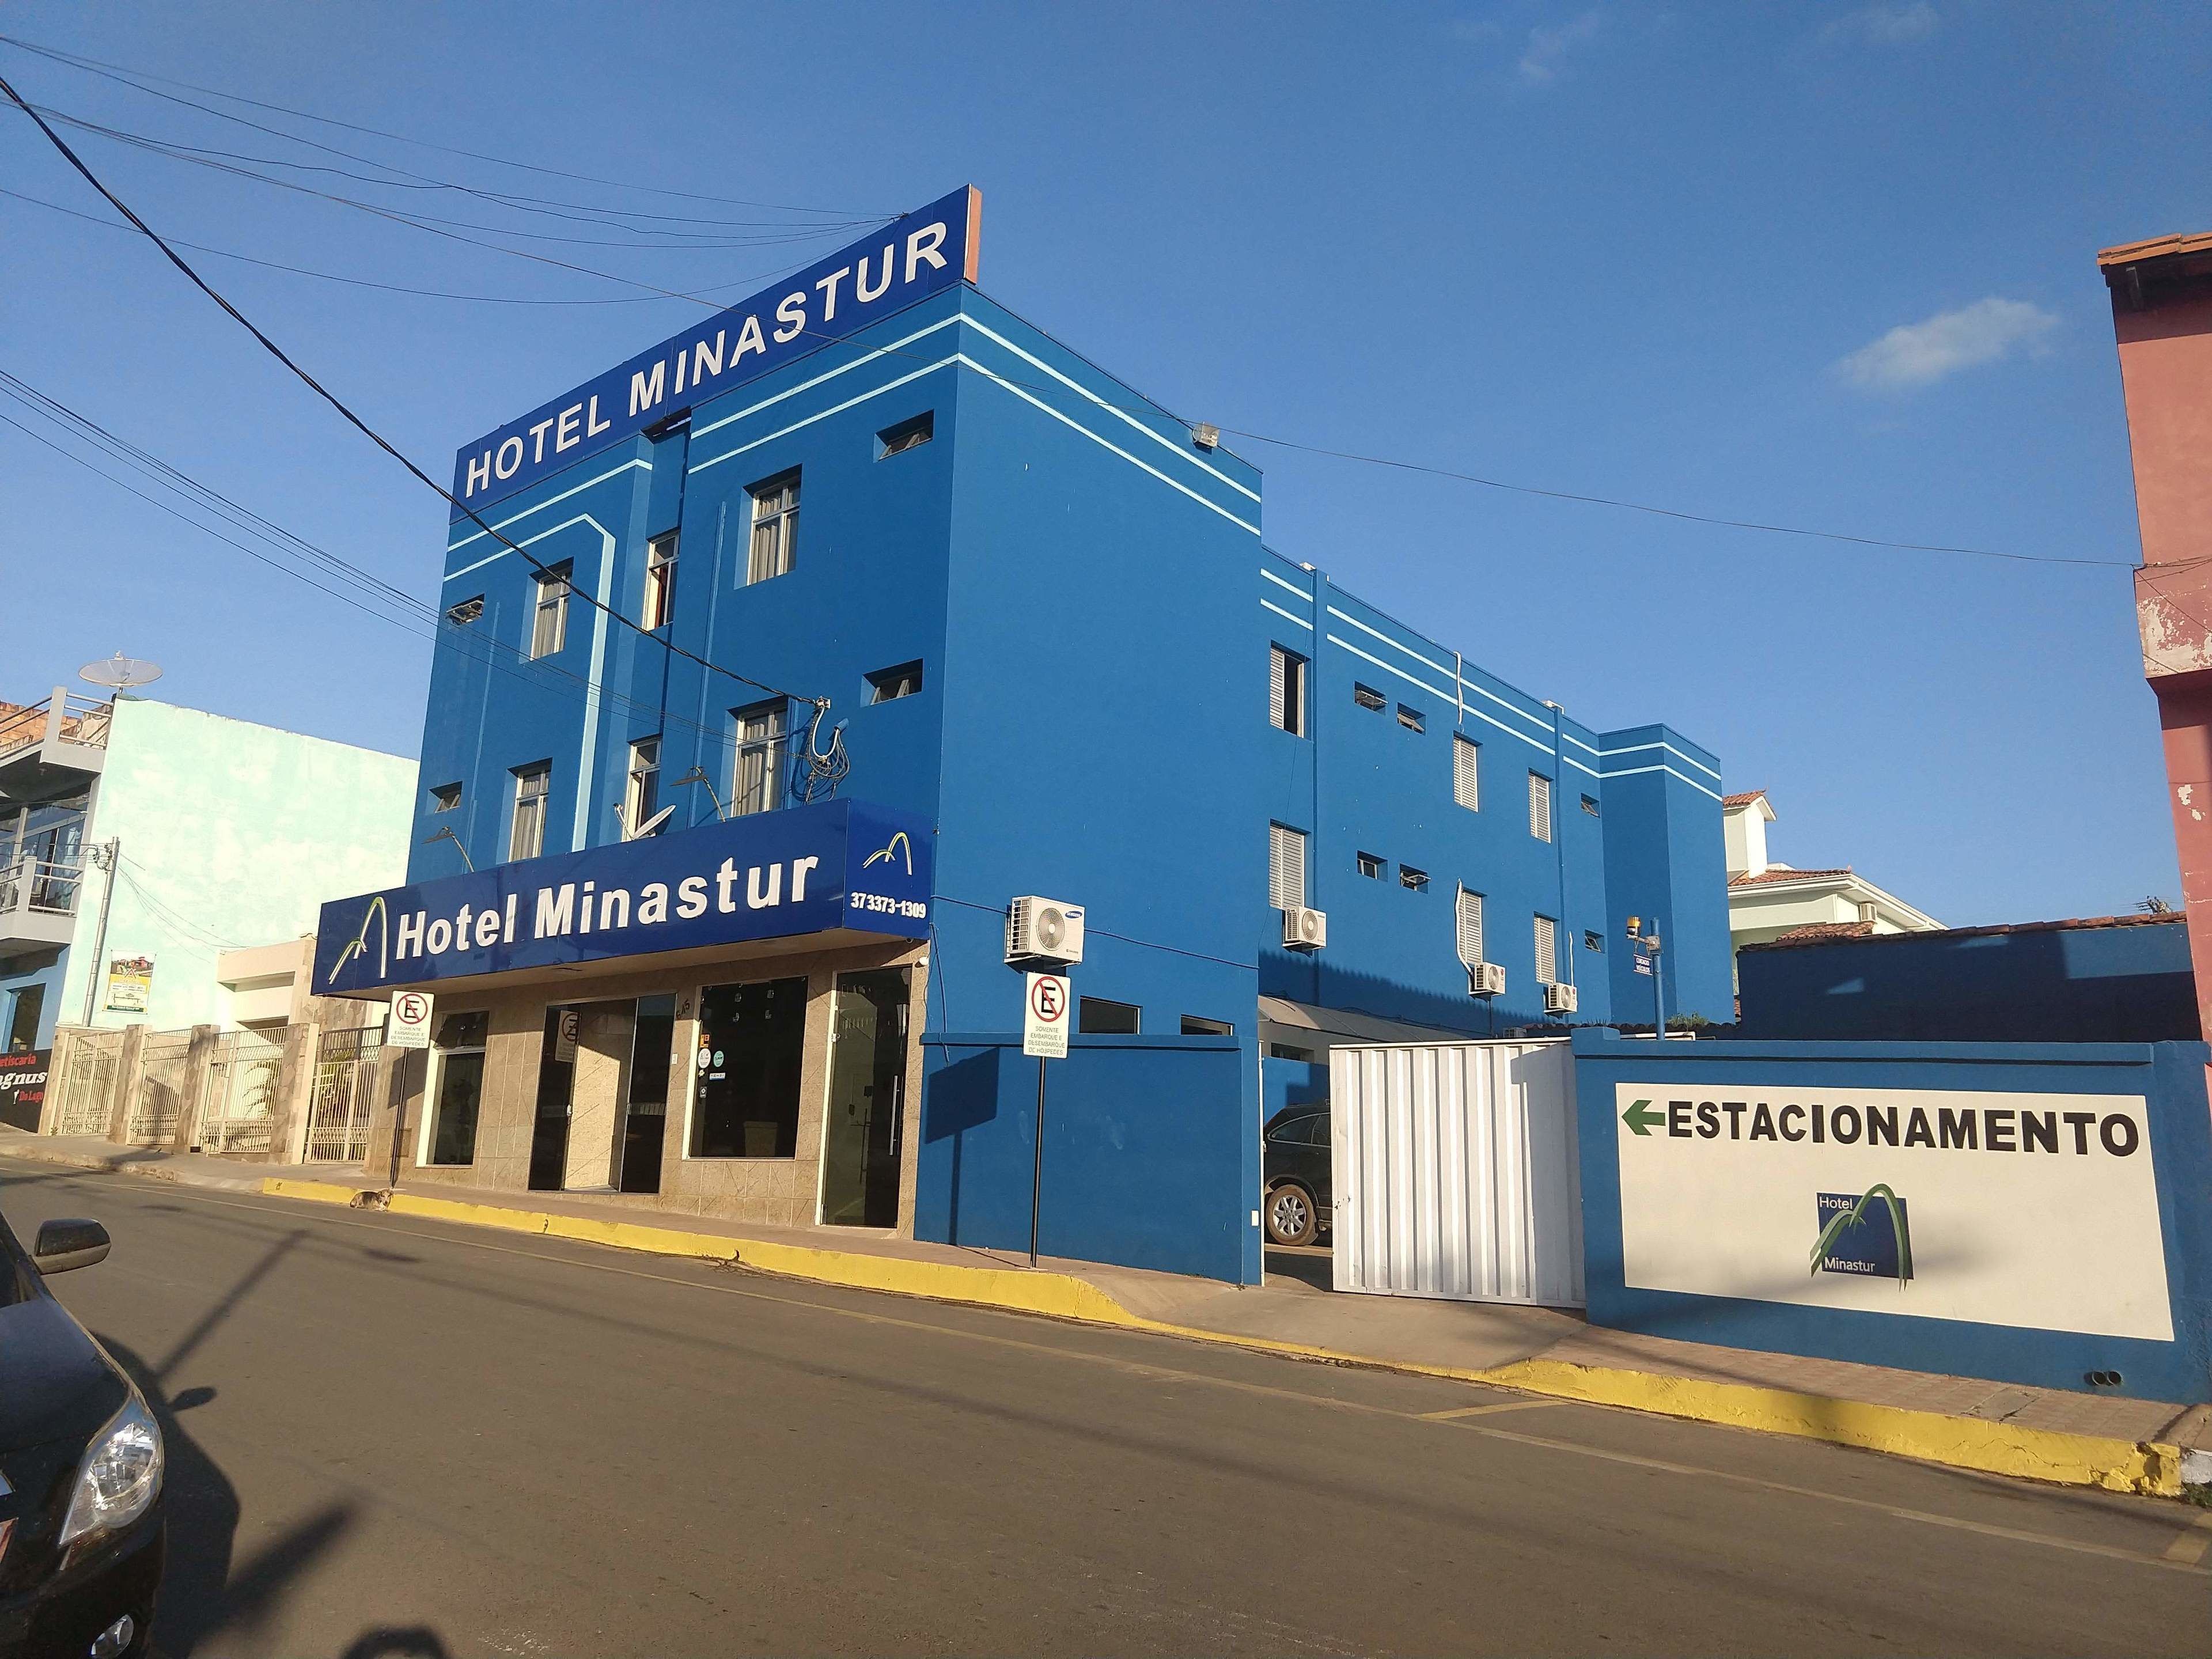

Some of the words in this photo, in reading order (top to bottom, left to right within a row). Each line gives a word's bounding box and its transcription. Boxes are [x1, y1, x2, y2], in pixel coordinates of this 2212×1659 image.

[466, 395, 611, 498] HOTEL
[628, 222, 948, 417] MINASTUR
[395, 893, 517, 960] Hotel
[534, 856, 819, 938] Minastur
[1028, 1040, 1065, 1048] DESEMBARQUE
[1668, 1100, 2139, 1157] ESTACIONAMENTO
[1819, 1196, 1853, 1209] Hotel
[1824, 1256, 1876, 1272] Minastur
